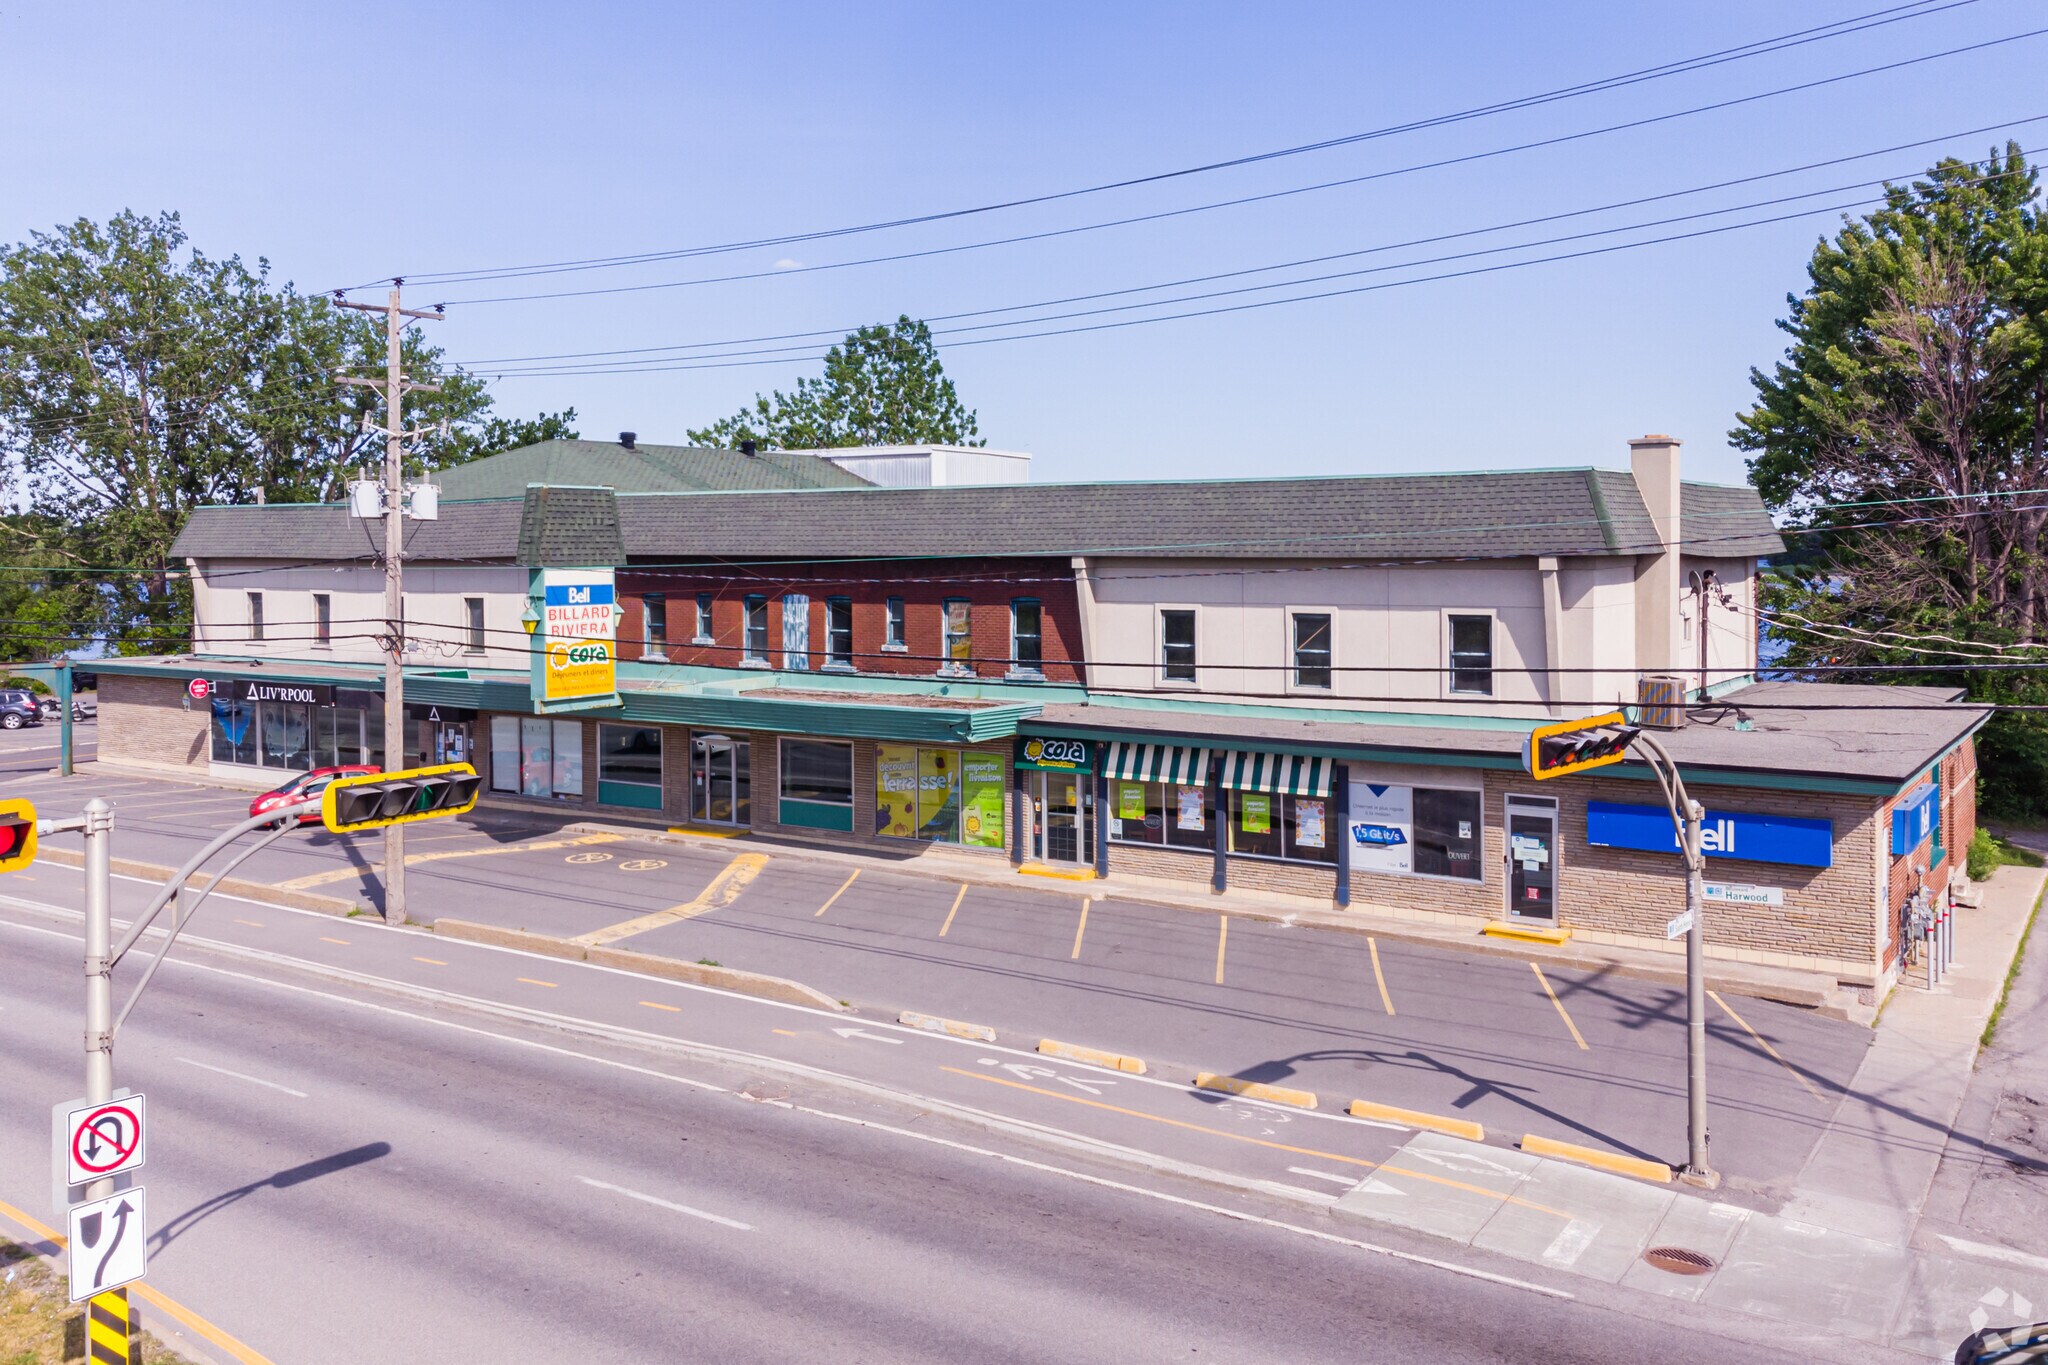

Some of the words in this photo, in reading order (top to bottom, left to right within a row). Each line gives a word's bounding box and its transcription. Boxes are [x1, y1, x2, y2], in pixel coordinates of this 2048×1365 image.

[568, 586, 590, 604] Bell
[548, 606, 610, 621] BILLARD
[551, 623, 608, 637] RIVIERA
[569, 646, 607, 663] cora
[1043, 740, 1085, 762] cora
[1369, 829, 1400, 841] Gbit/s
[1448, 851, 1470, 860] OUVERT
[1725, 891, 1768, 902] Harwood
